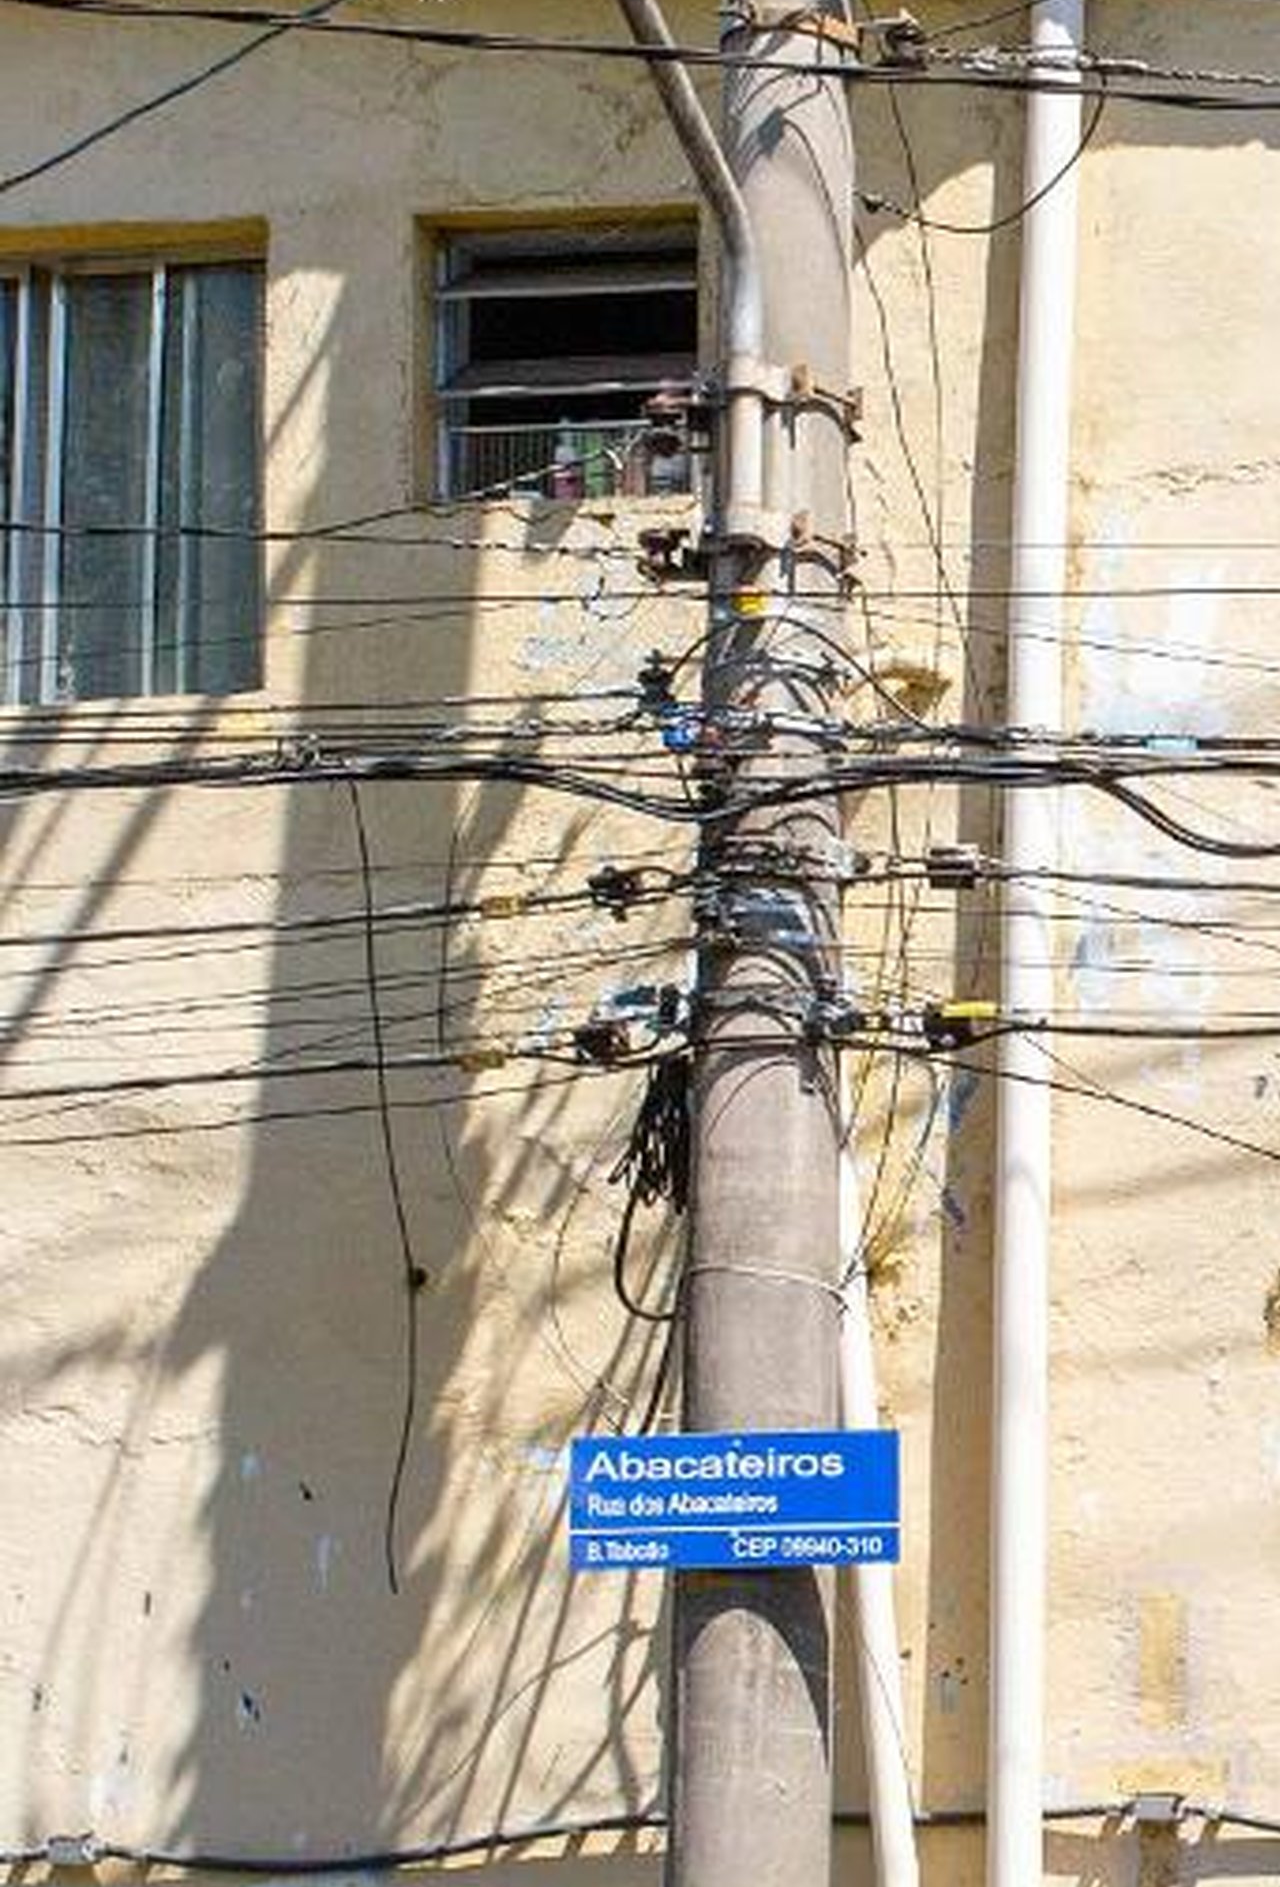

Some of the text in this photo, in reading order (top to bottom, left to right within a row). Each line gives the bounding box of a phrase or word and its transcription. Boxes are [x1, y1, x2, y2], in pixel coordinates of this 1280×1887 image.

[585, 1448, 845, 1481] Abacateiros
[587, 1491, 779, 1516] Rua dos Abacateiros
[733, 1537, 778, 1558] CEP
